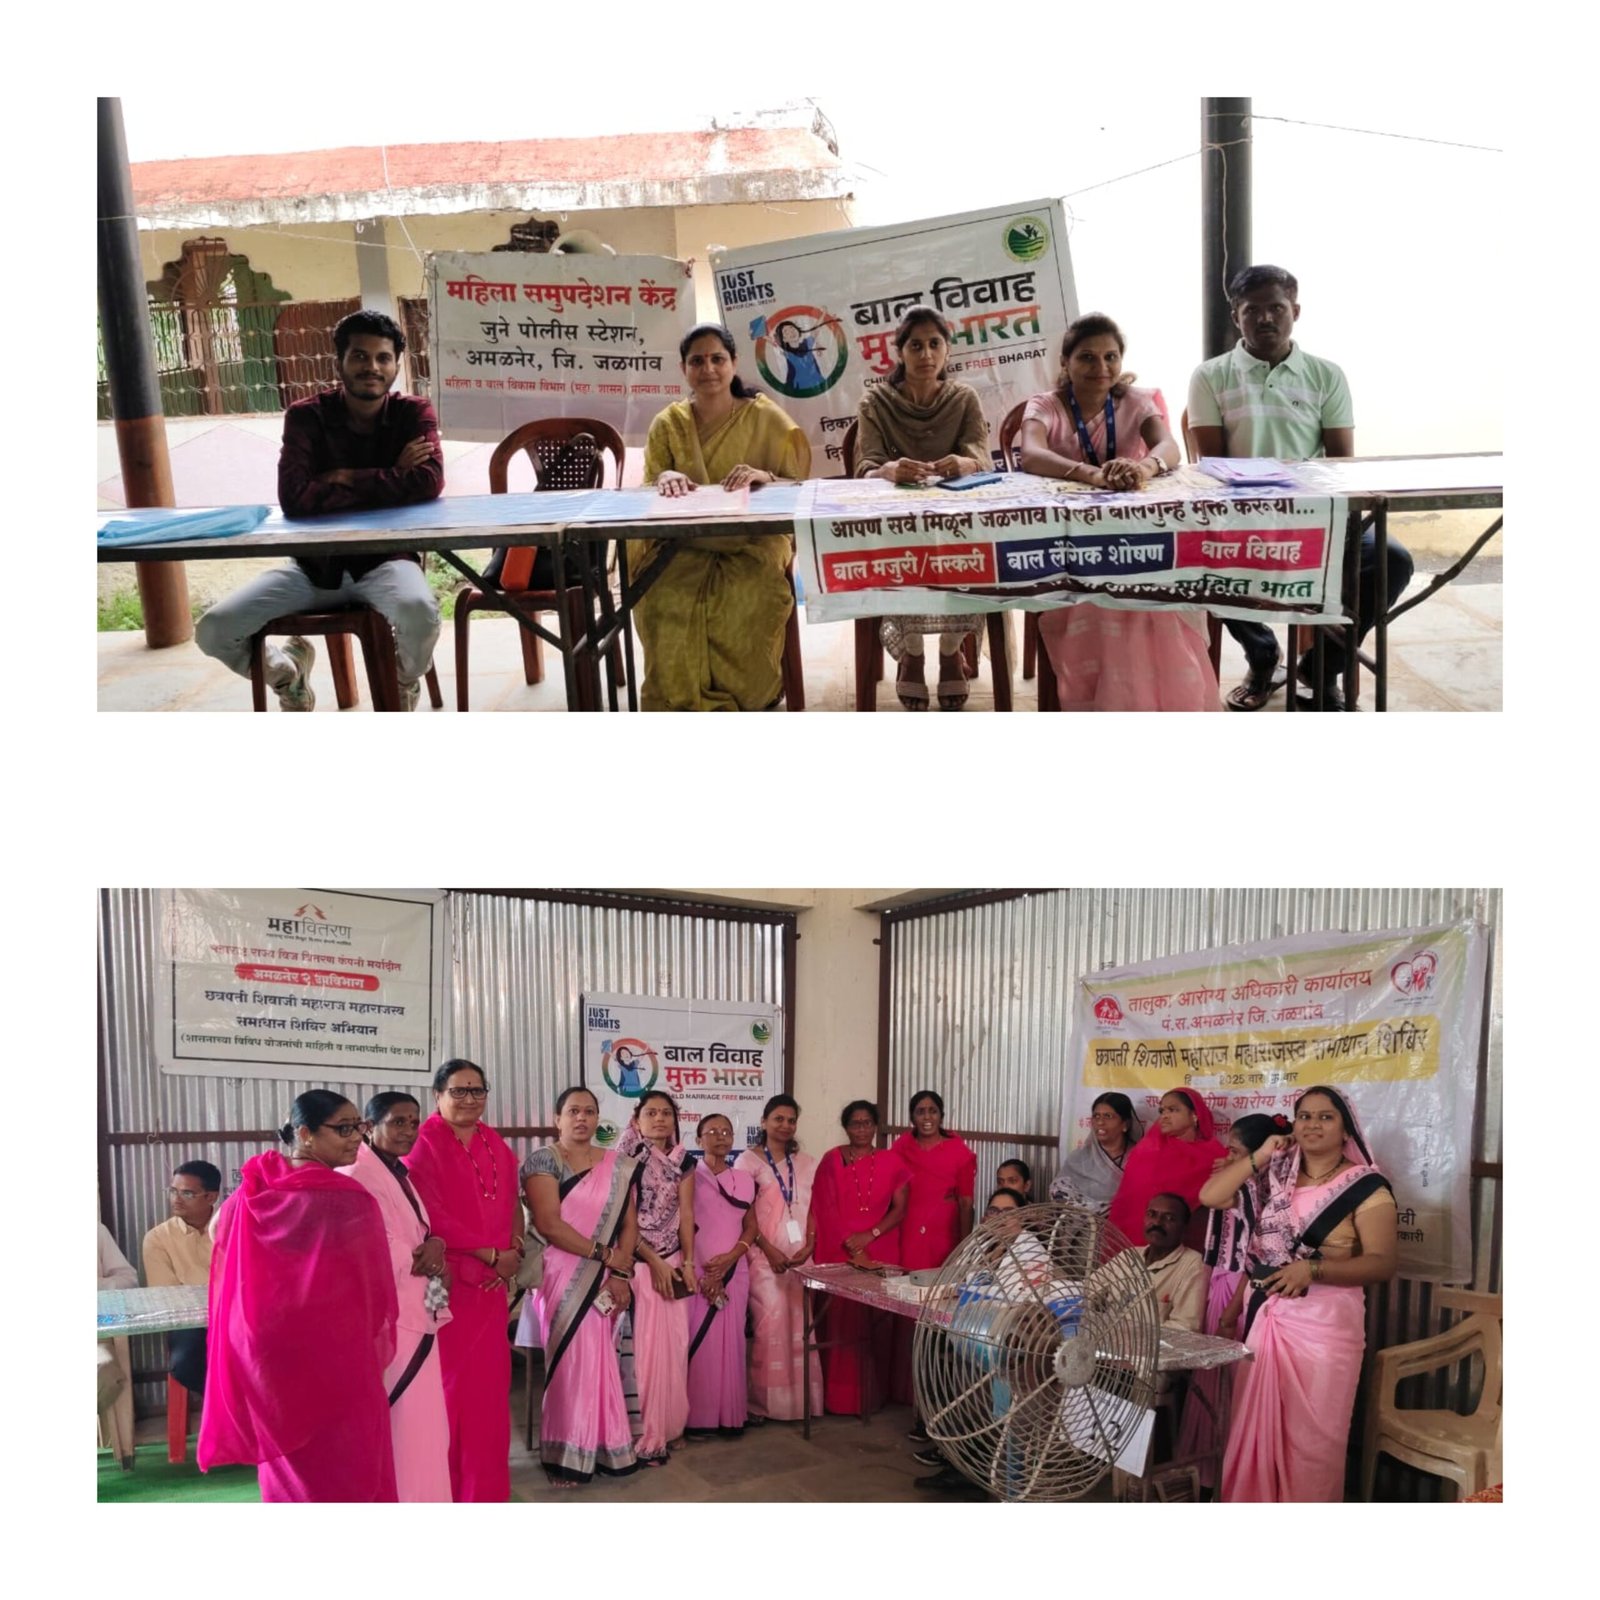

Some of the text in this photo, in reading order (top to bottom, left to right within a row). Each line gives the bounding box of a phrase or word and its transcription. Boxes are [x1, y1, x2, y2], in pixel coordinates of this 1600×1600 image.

[721, 270, 755, 290] JUST
[446, 274, 677, 313] महिला समुपदेशन केंद्र
[723, 283, 775, 306] RIGHTS
[930, 276, 1036, 313] विवाह
[480, 315, 645, 346] जुने पोलीस स्टेशन,
[465, 345, 663, 373] अमळनेर, जि. जळगांव
[965, 357, 997, 371] FREE
[998, 348, 1048, 366] BHARAT
[830, 518, 882, 538] आपण
[921, 510, 973, 540] मिळून
[1006, 549, 1045, 571] बाल
[1107, 538, 1165, 565] शोषण
[1200, 534, 1302, 564] बाल विवाह
[830, 561, 868, 582] बाल
[1260, 580, 1315, 599] भारत
[1177, 984, 1225, 1007] आरोग्य
[1230, 974, 1299, 1002] अधिकारी
[1303, 967, 1374, 993] कार्यालय
[204, 989, 248, 1004] छत्रपती
[251, 992, 298, 1008] शिवाजी
[300, 998, 346, 1013] महाराज
[589, 1007, 610, 1018] JUST
[236, 1016, 287, 1031] समाधान
[331, 1021, 378, 1037] अभियान
[588, 1018, 620, 1030] RIGHTS
[663, 1042, 764, 1068] बाल विवाह
[1095, 1041, 1130, 1067] छत्रपती
[1132, 1041, 1177, 1068] शिवाजी
[1180, 1046, 1229, 1070] महाराज
[664, 1066, 765, 1093] मुक्त भारत
[1232, 1091, 1276, 1110] आरोग्य
[747, 1126, 761, 1136] JUS
